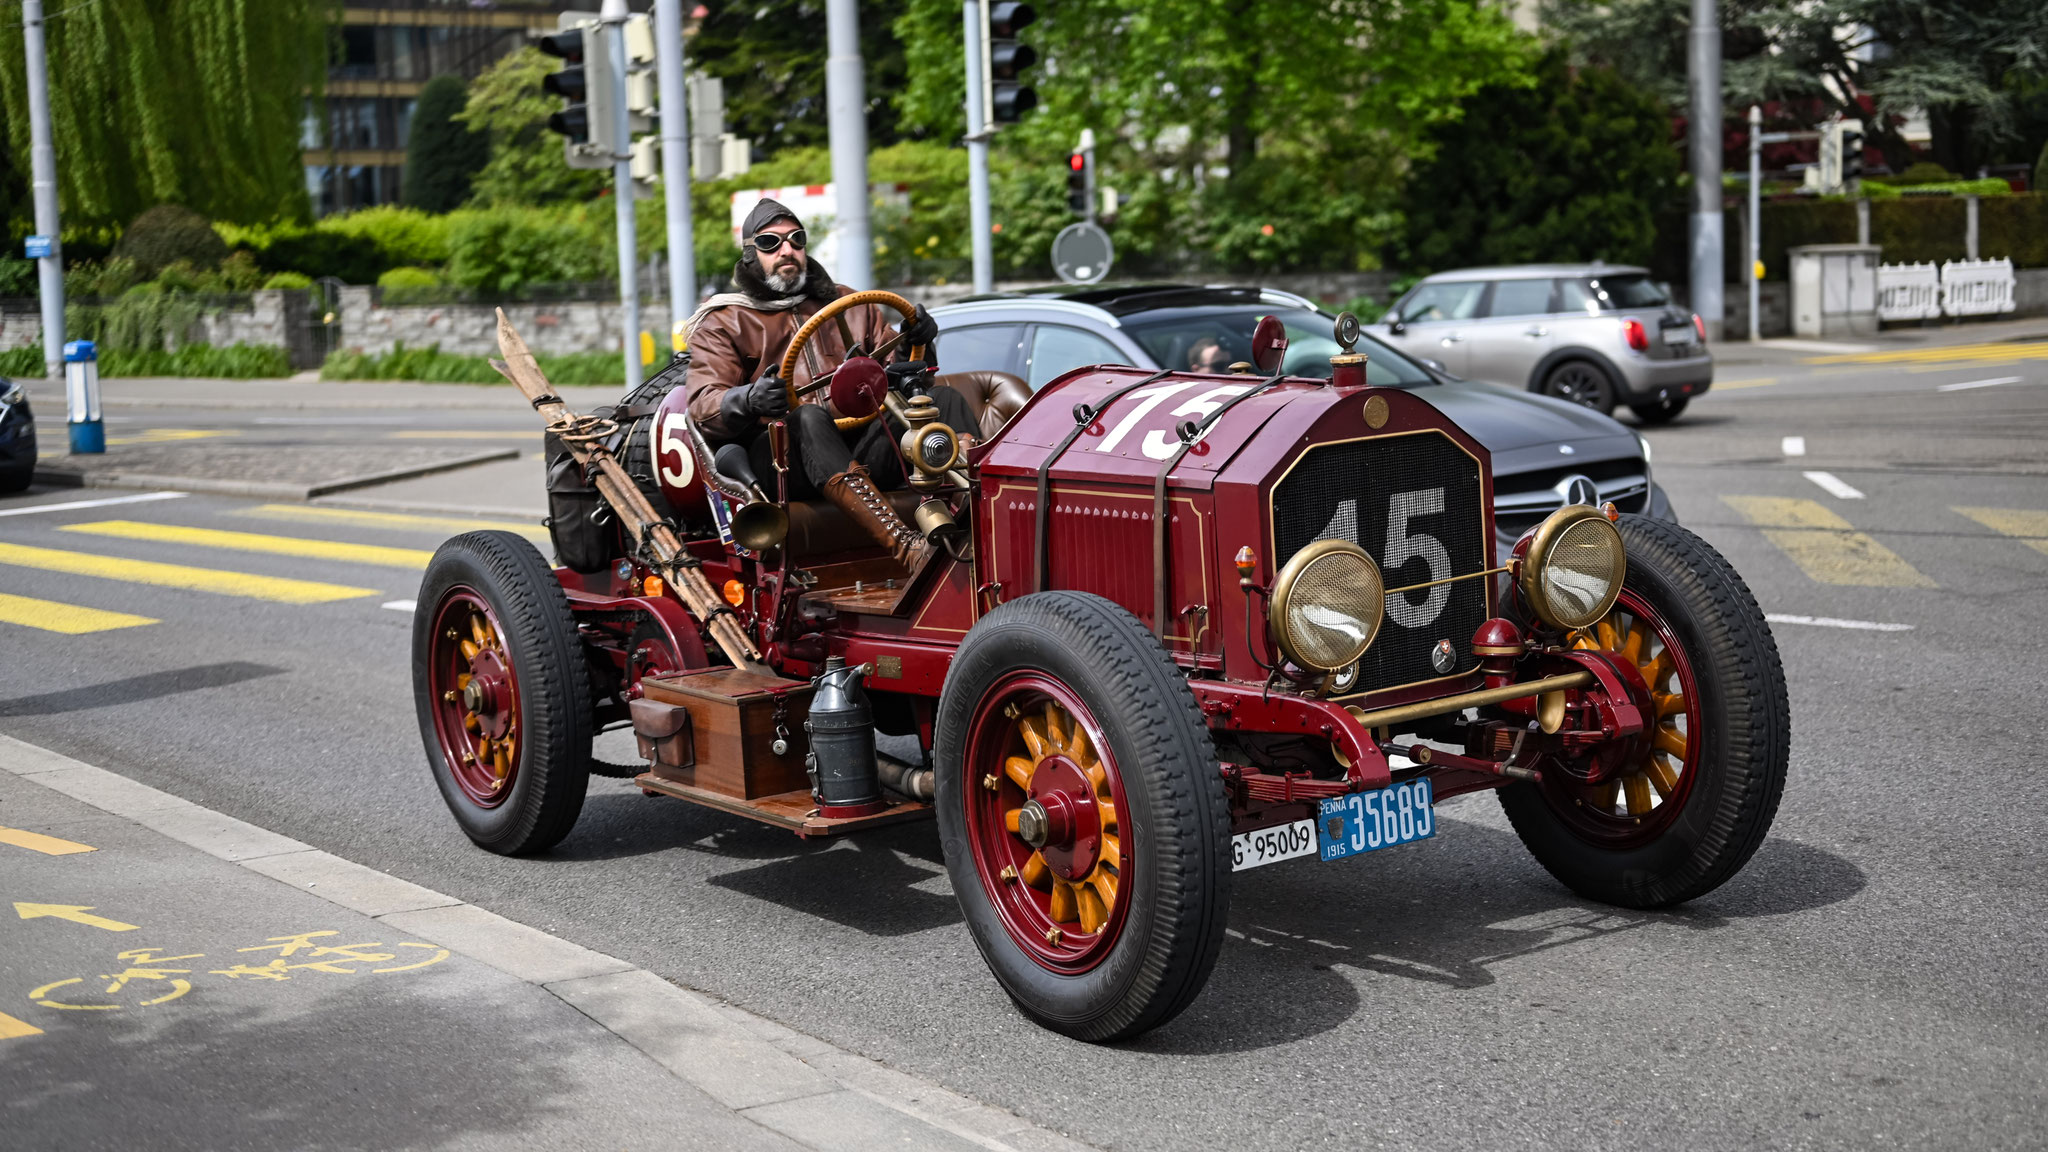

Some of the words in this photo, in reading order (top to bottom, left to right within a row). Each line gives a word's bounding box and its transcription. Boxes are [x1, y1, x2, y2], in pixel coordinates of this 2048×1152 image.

[1095, 382, 1270, 461] 15
[1320, 800, 1347, 816] PENNA
[1349, 782, 1431, 852] 35689
[1255, 826, 1310, 862] 95009
[1327, 843, 1346, 858] 1915
